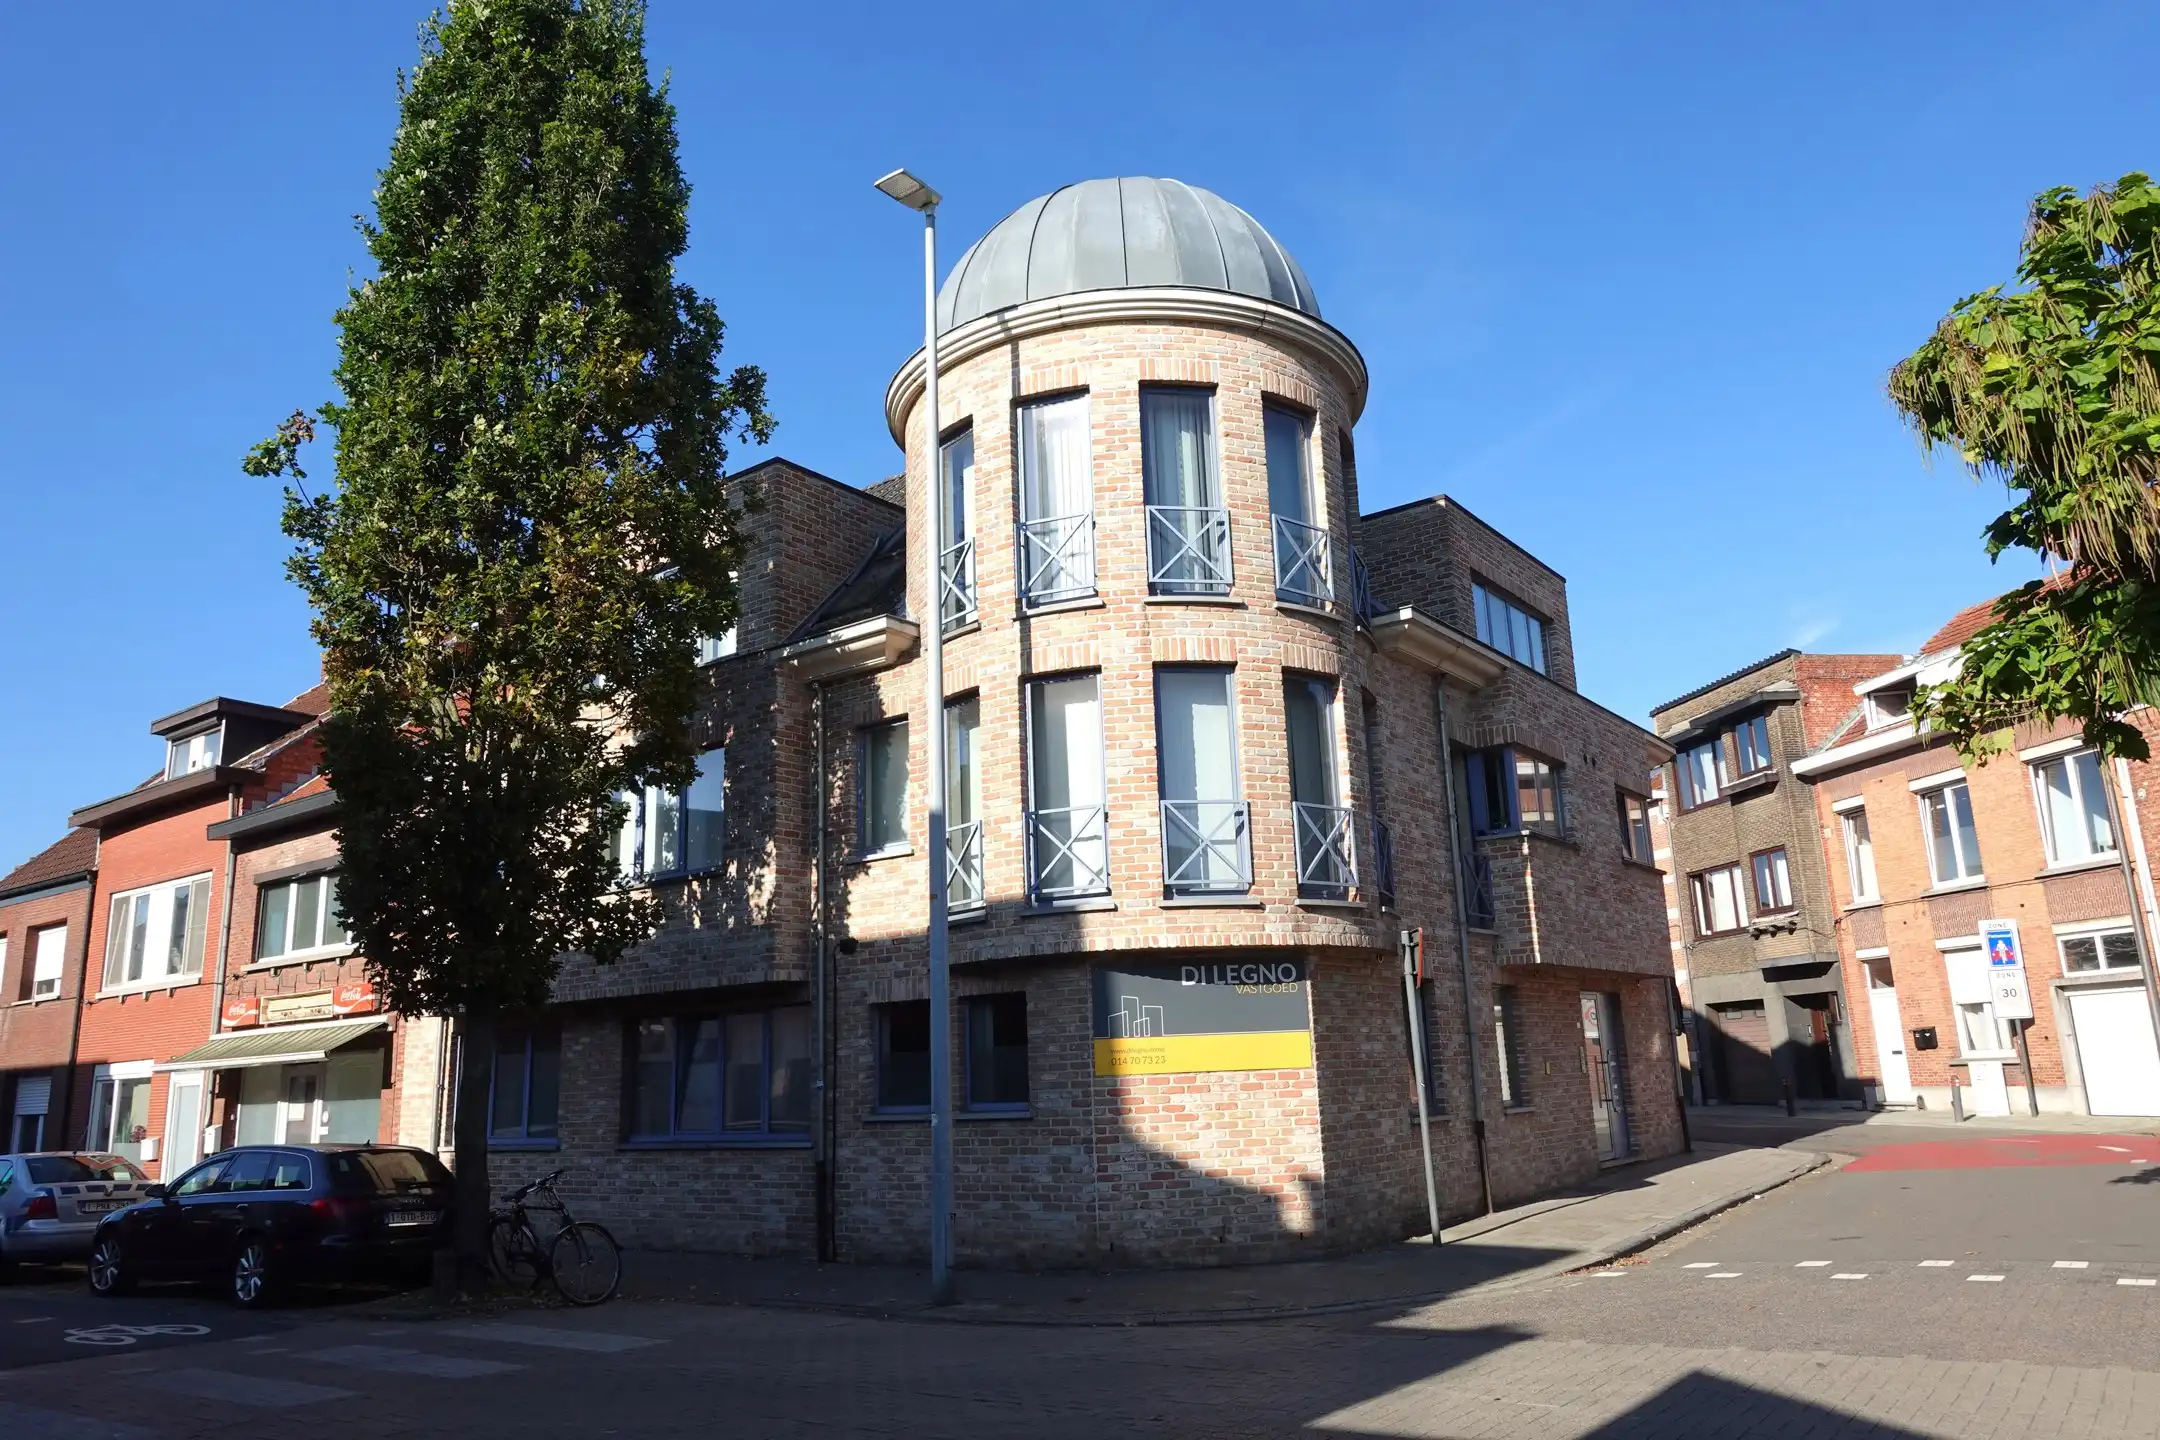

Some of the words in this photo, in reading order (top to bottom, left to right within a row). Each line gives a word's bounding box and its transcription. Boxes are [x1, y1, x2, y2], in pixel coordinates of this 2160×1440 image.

[1181, 966, 1206, 986] DI
[1212, 963, 1297, 986] LEGNO
[1235, 982, 1298, 994] VASTGOED
[2002, 988, 2018, 998] 30
